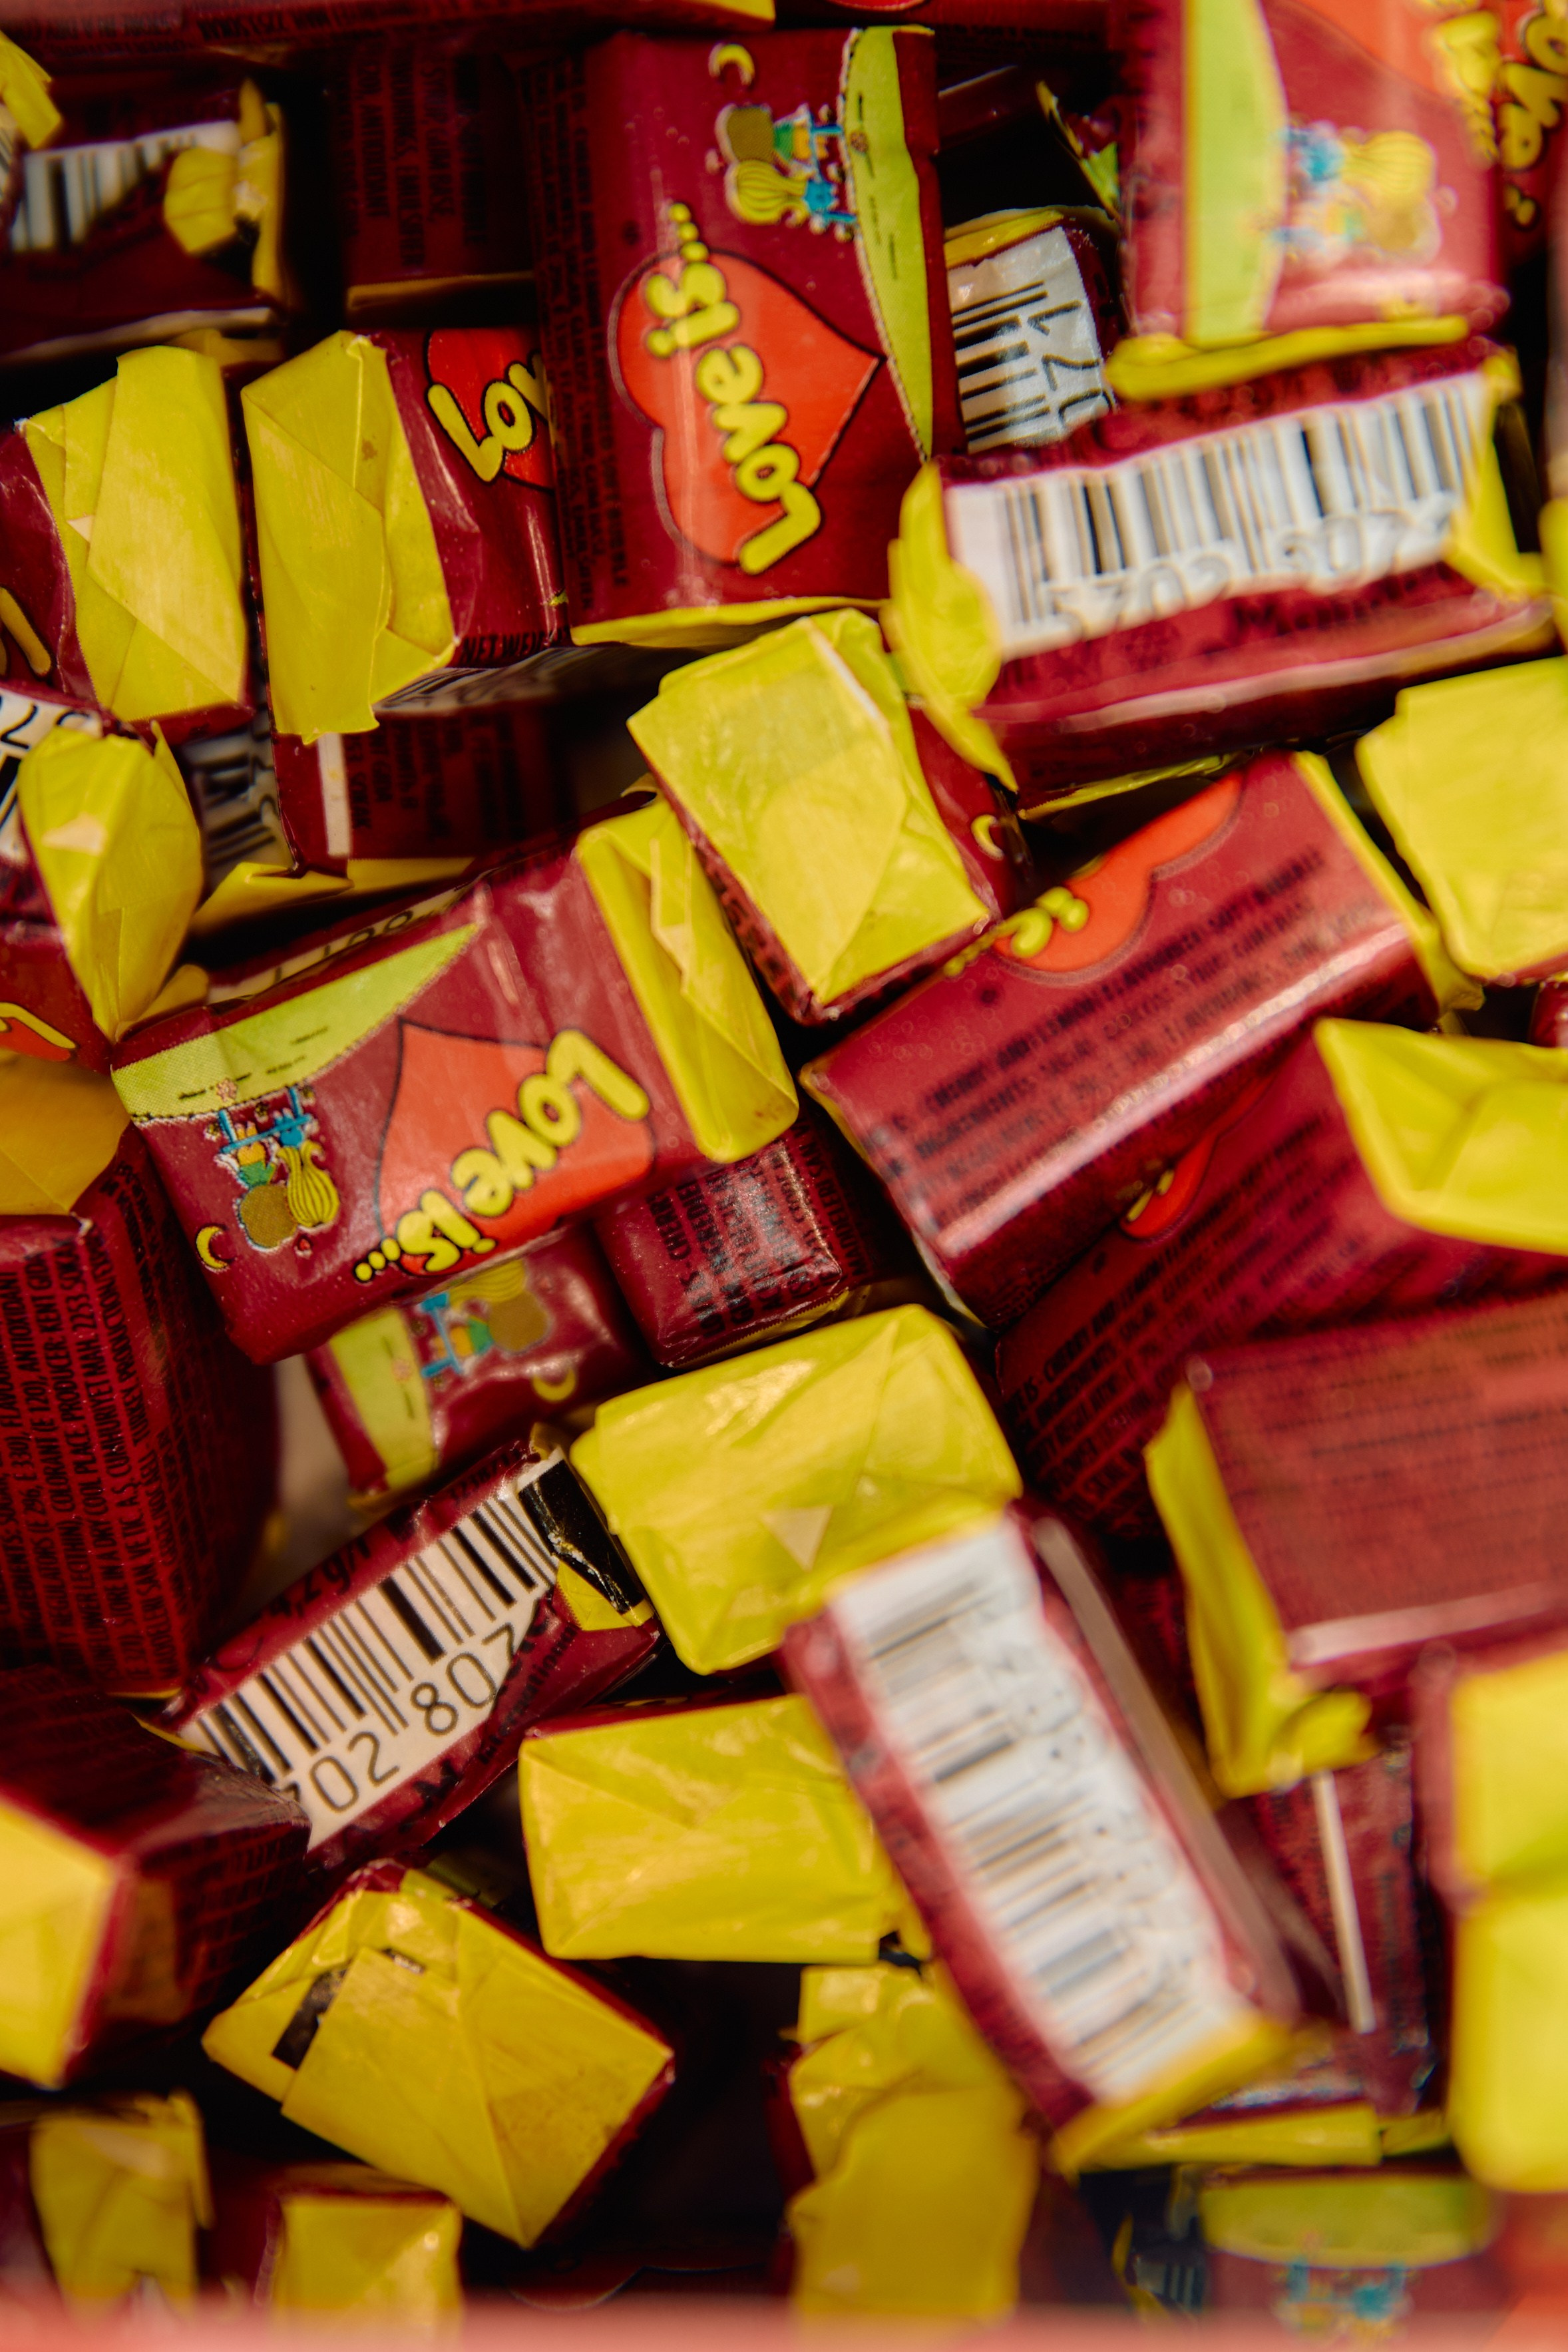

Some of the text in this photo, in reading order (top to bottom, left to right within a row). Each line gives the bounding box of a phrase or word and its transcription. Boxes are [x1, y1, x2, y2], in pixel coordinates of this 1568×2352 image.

[427, 350, 550, 482] Lov
[451, 1029, 650, 1218] Love
[30, 1292, 63, 1335] KENT
[63, 1291, 98, 1332] 2253
[41, 1334, 86, 1423] PRODUCER:
[33, 1433, 76, 1515] COLORANT
[76, 1477, 108, 1519] COOL
[401, 1620, 542, 1743] 807
